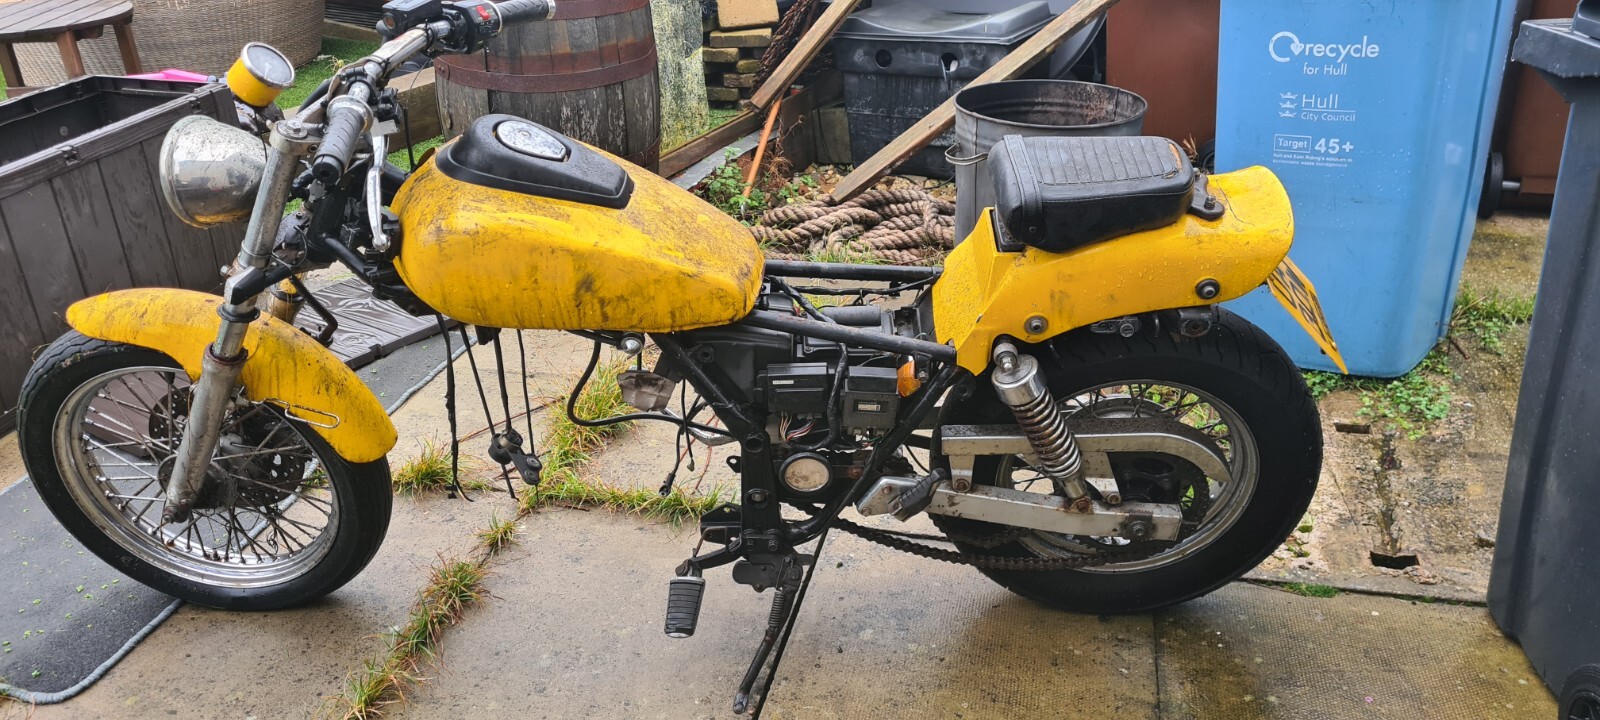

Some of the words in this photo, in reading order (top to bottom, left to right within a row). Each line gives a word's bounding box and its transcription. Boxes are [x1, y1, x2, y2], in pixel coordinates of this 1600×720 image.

[1304, 35, 1379, 63] recycle
[1303, 62, 1319, 74] for
[1323, 63, 1347, 75] Hull
[1302, 93, 1338, 109] Hull
[1301, 111, 1319, 122] City
[1321, 112, 1356, 122] Council
[1278, 138, 1308, 149] Target
[1314, 137, 1354, 155] 45+
